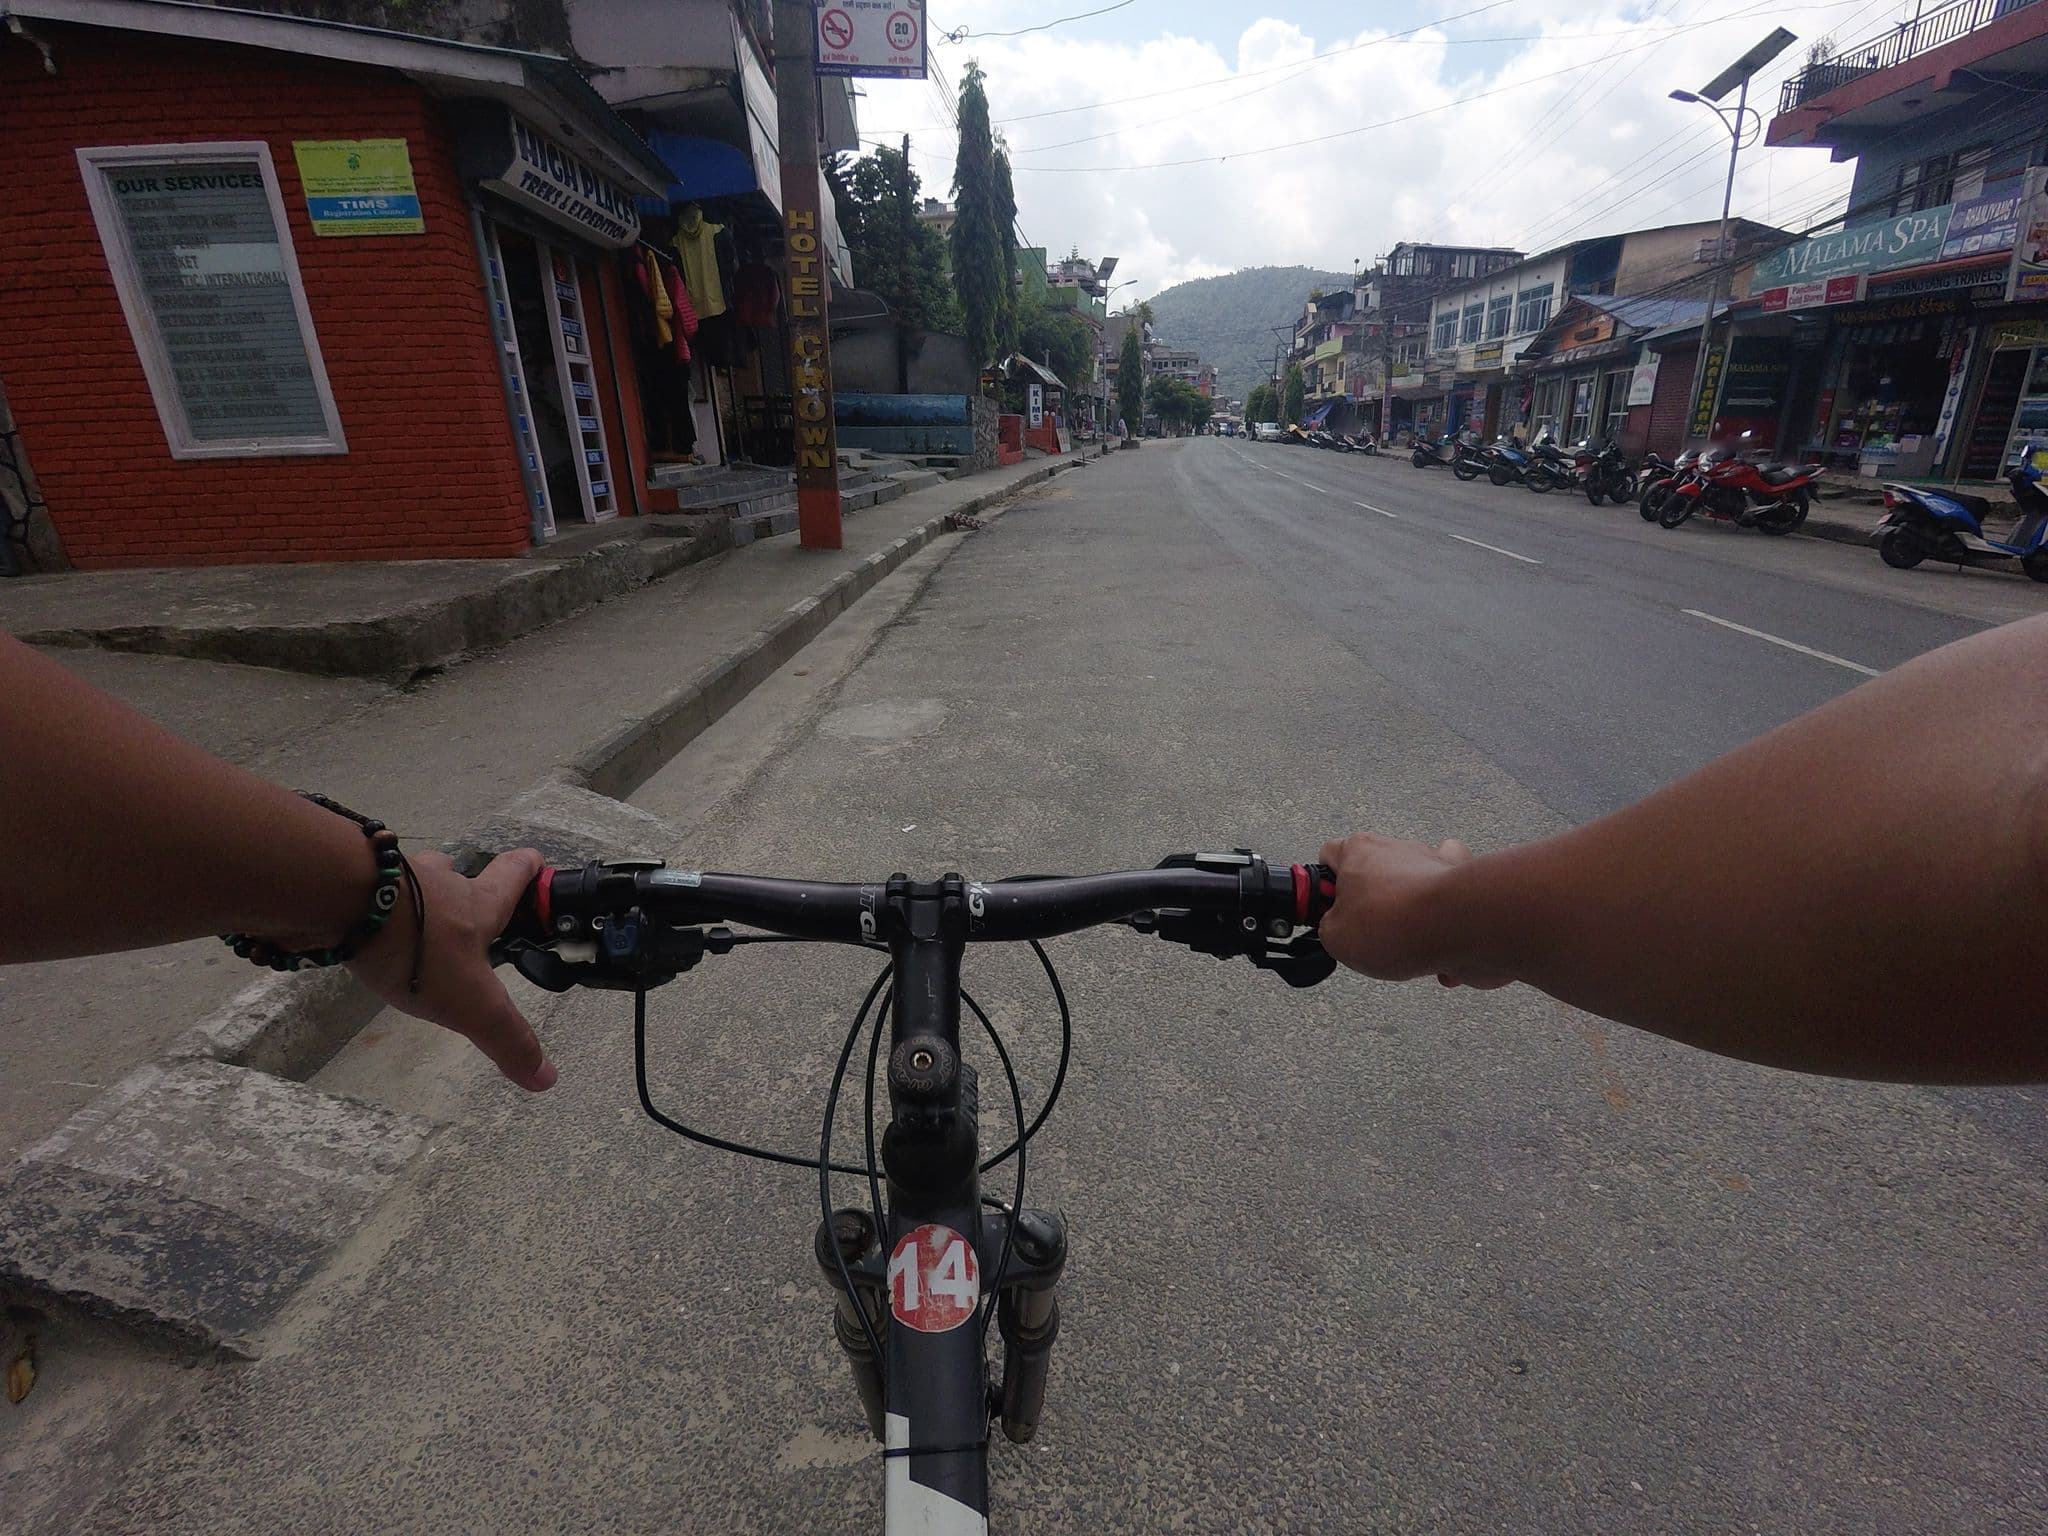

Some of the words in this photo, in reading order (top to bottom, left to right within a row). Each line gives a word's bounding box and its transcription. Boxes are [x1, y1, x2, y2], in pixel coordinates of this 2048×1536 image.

[894, 22, 909, 35] 20
[516, 126, 579, 192] HIGH
[116, 178, 161, 194] OUR
[164, 174, 264, 191] SERVICES
[323, 209, 372, 217] Registration
[373, 208, 408, 216] Counter
[337, 199, 389, 210] TIMS
[519, 170, 563, 208] TREKS
[558, 194, 569, 211] &
[567, 199, 629, 241] EXPEDITION
[788, 209, 820, 317] HOTEL
[1780, 230, 1884, 278] MALAMA
[1955, 270, 2004, 287] TRAVELS
[792, 334, 831, 468] CROWN
[1031, 389, 1041, 422] KIMS
[889, 1240, 973, 1311] 14
